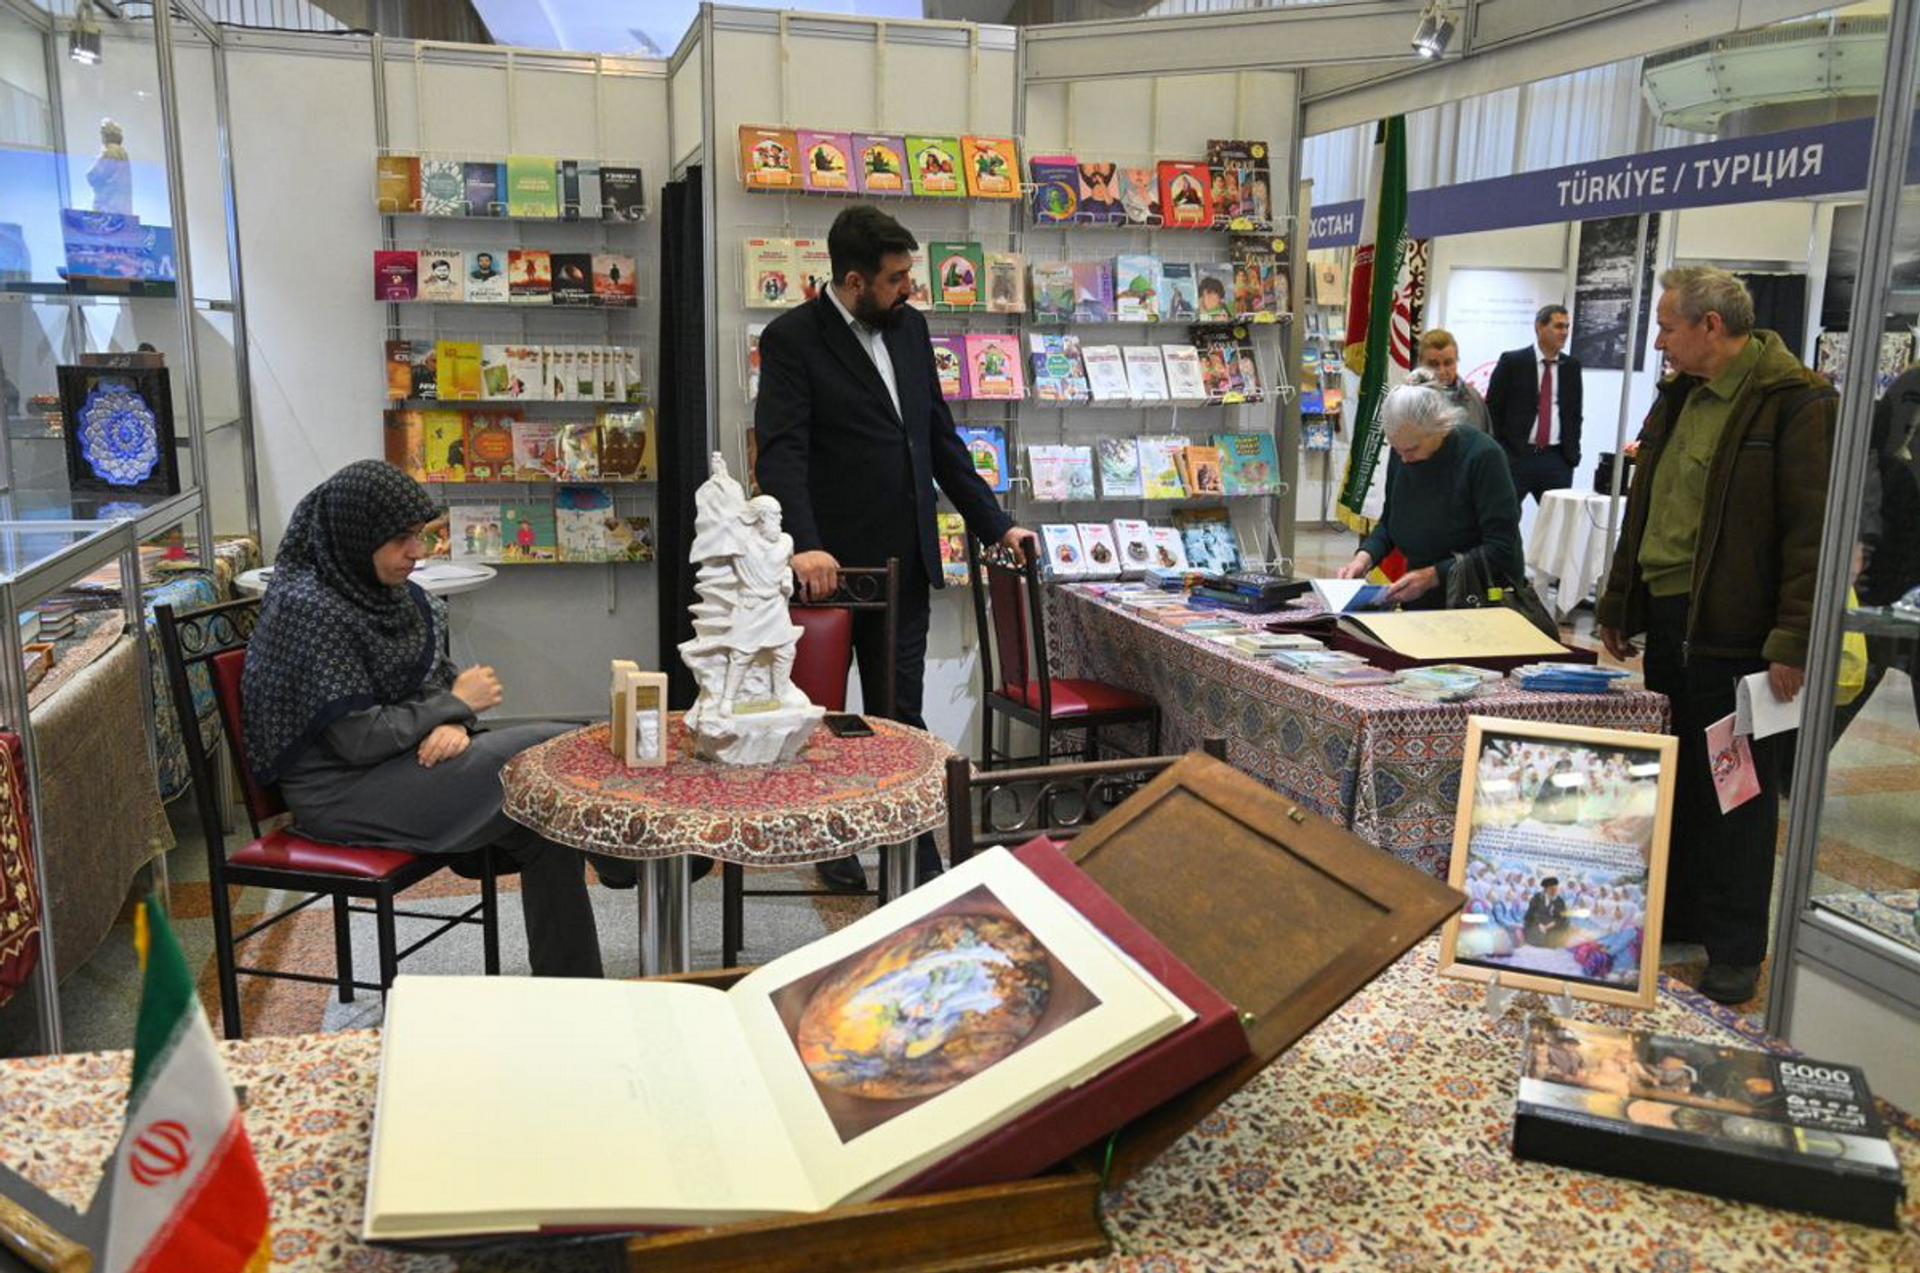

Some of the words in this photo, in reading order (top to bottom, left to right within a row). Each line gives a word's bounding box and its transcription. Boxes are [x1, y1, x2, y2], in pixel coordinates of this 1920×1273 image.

[1558, 162, 1667, 207] TÜRKİYE
[1673, 163, 1686, 193] /
[1694, 144, 1824, 190] ТУРЦИЯ
[1780, 1062, 1850, 1082] 5000
